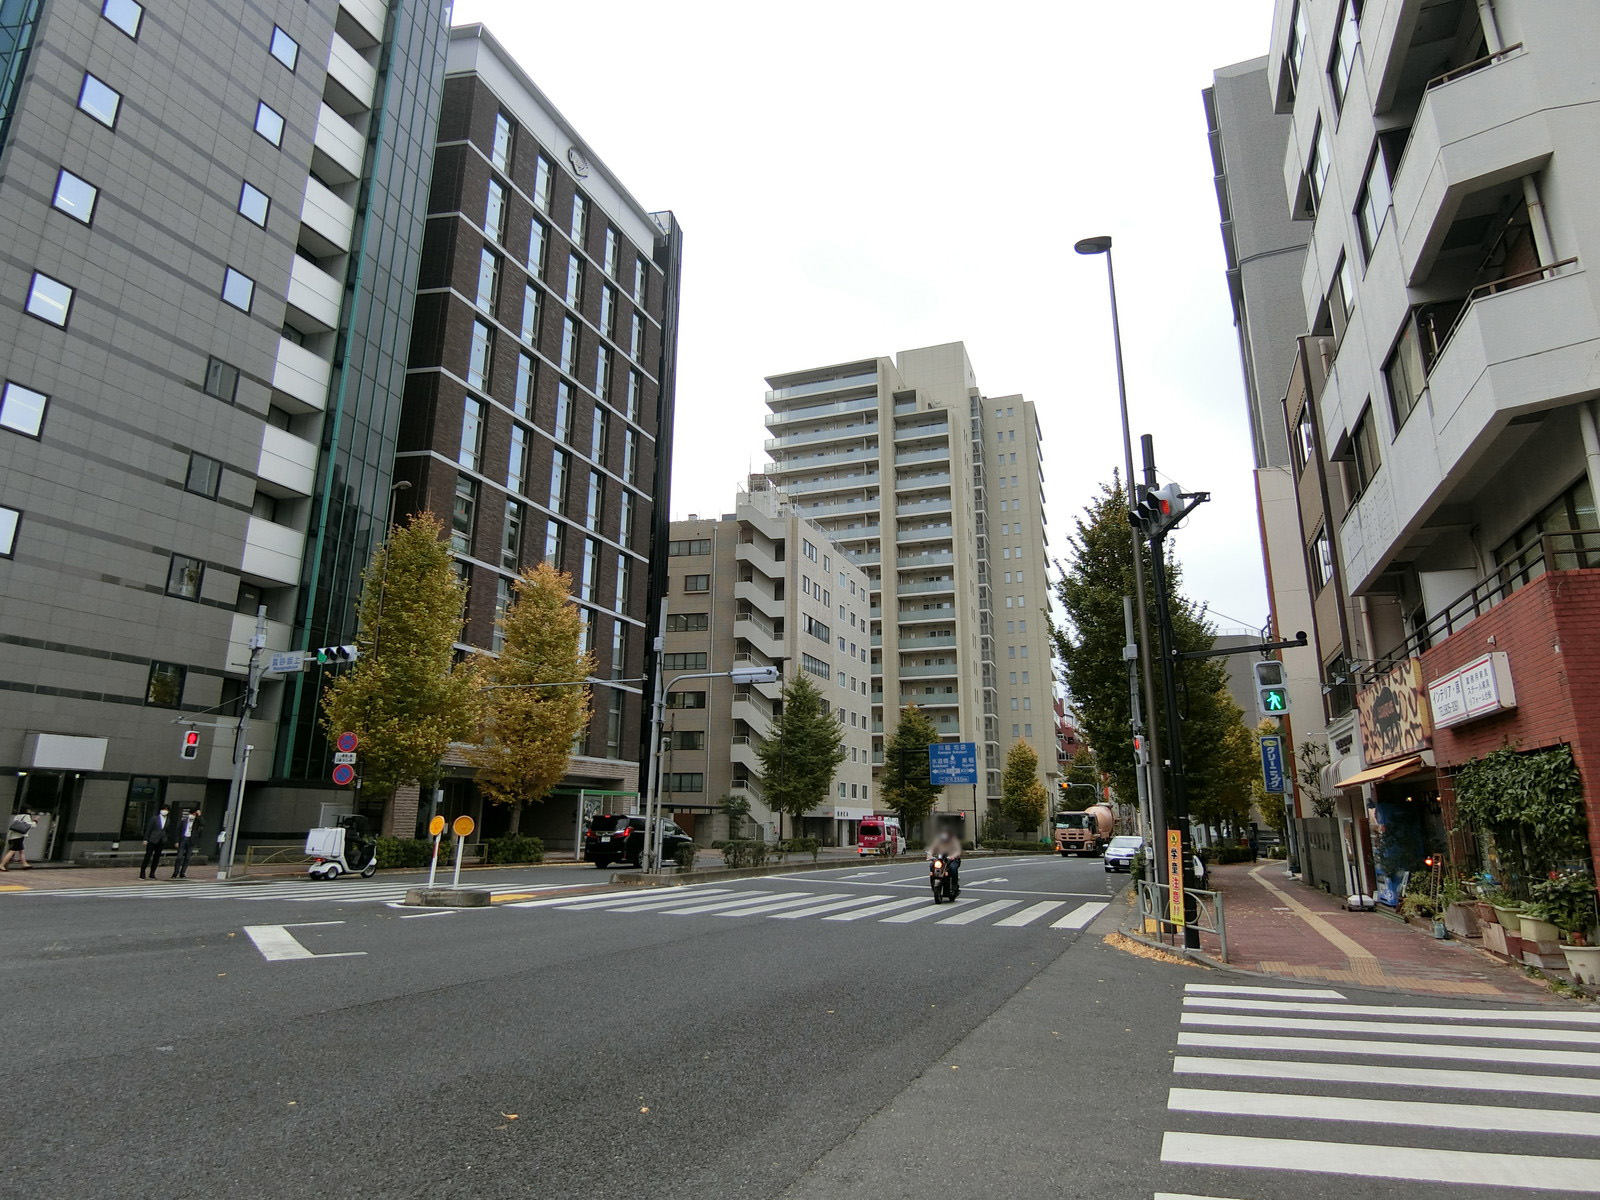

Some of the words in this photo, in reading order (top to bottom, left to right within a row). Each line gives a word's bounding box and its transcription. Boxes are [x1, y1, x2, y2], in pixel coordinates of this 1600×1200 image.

[1267, 746, 1281, 788] クリーニング
